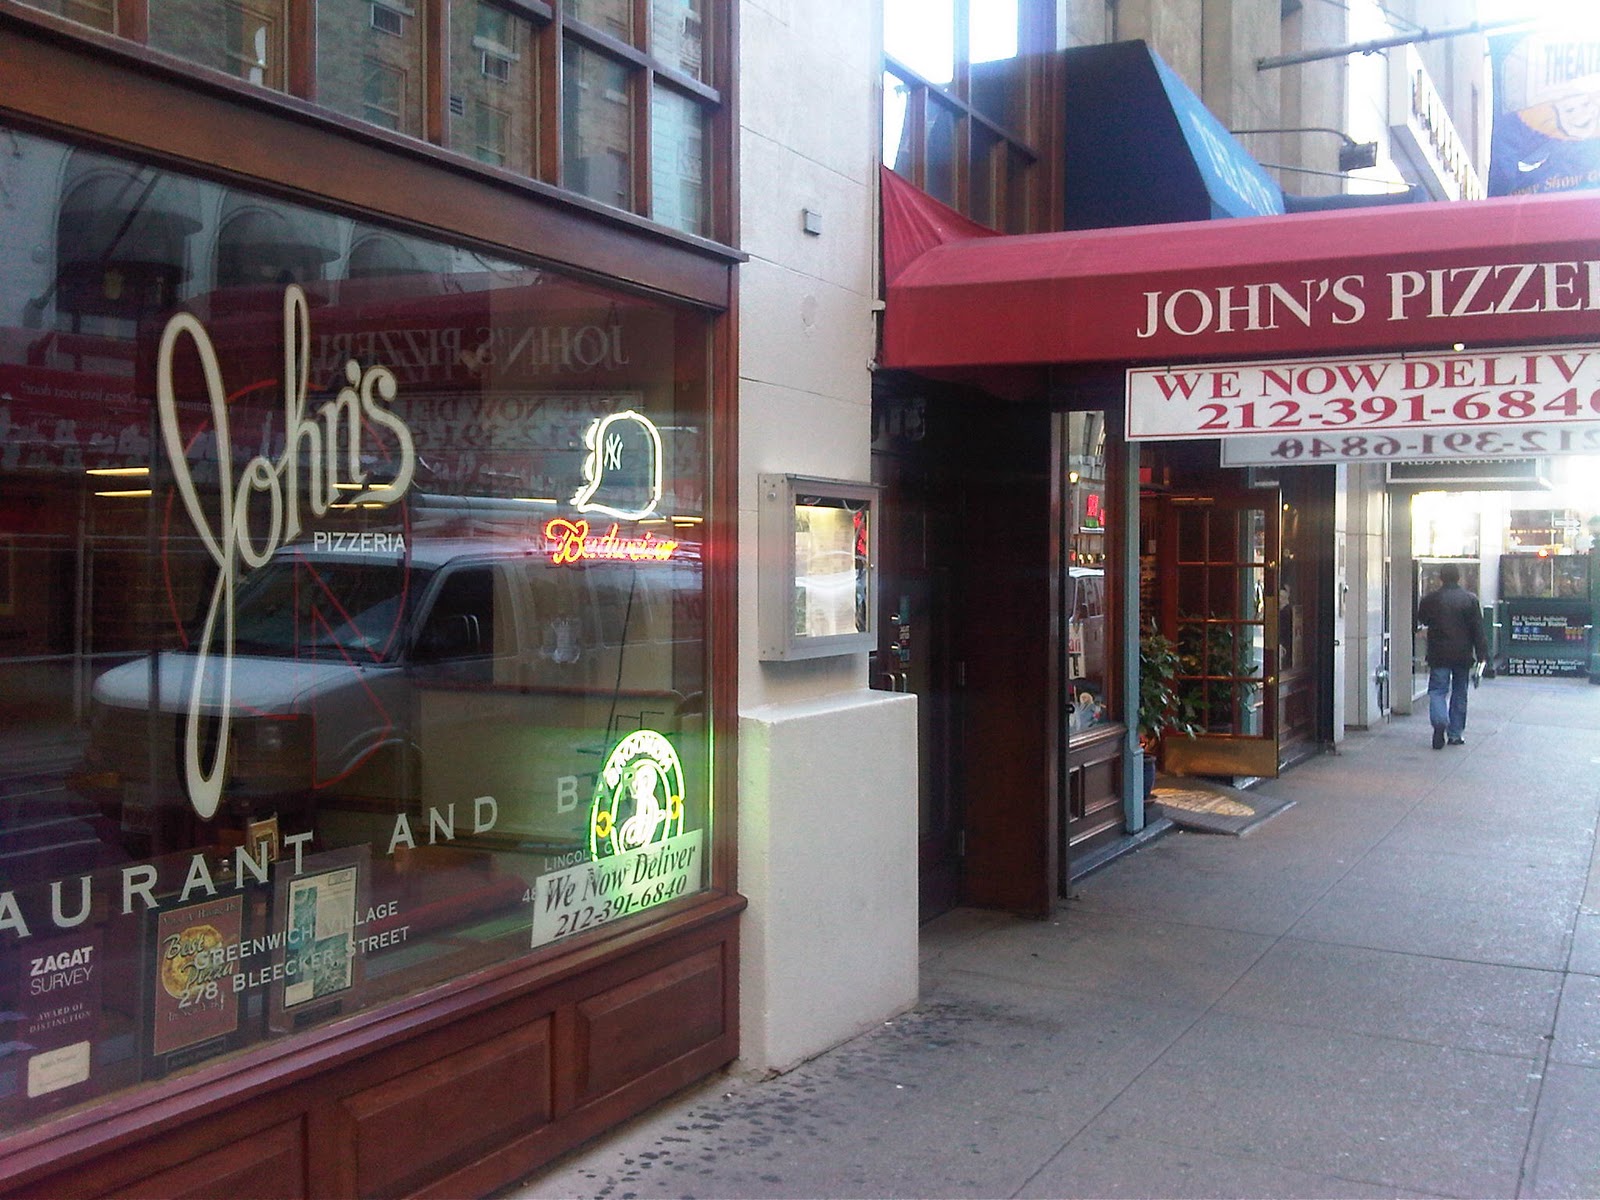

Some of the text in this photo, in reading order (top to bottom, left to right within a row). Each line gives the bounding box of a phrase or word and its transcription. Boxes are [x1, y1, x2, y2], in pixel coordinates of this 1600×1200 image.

[1137, 275, 1366, 339] JOHN'S
[1153, 352, 1600, 401] WE NOW DELIV
[156, 283, 416, 819] John's
[313, 530, 407, 554] PIZZERIA
[387, 796, 499, 855] AND
[545, 848, 598, 872] LINCOL
[545, 873, 576, 913] We
[581, 864, 629, 902] Now
[632, 844, 697, 885] Deliver
[553, 873, 688, 938] 212-391-6840
[30, 946, 94, 977] ZAGAT
[163, 934, 206, 962] Best
[178, 926, 411, 1009] 278 BLEECKER STREET
[194, 923, 314, 970] GREENWICH
[30, 965, 94, 996] SURVEY
